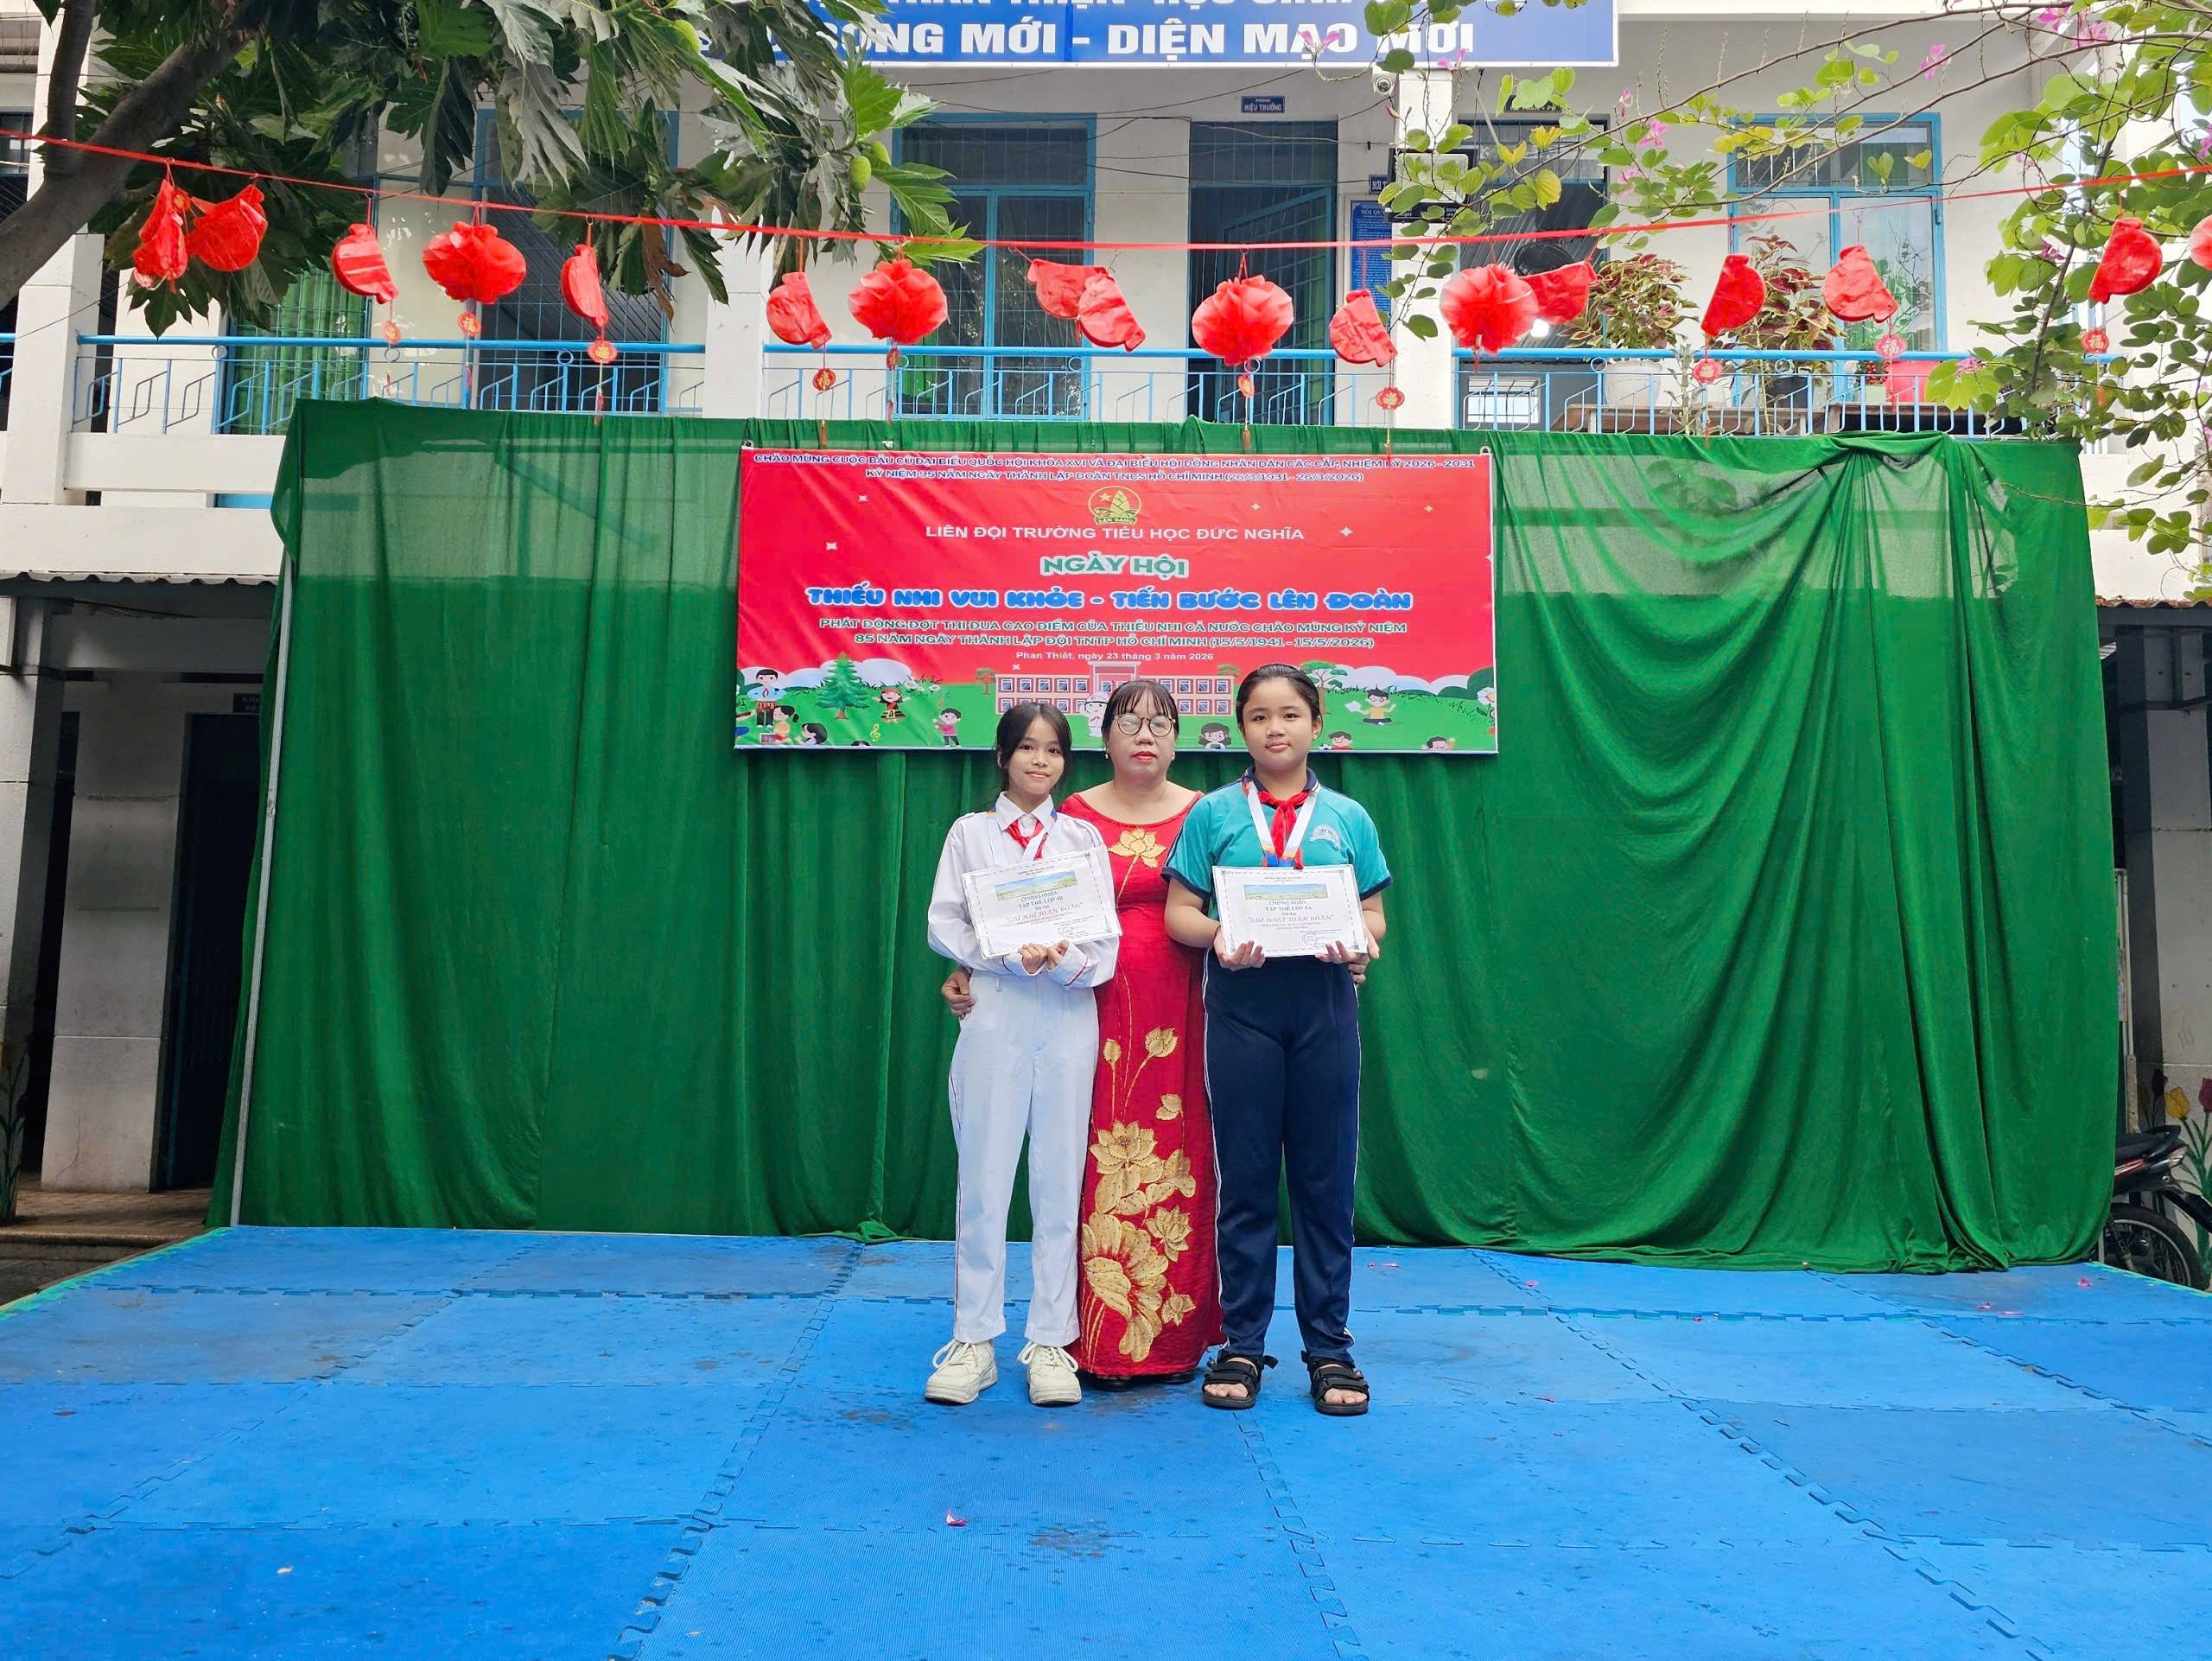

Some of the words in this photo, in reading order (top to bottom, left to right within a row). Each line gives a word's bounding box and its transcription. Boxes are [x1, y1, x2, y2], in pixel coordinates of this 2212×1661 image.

[960, 16, 1058, 54] MỚI
[1108, 19, 1227, 60] DIỆN
[1243, 22, 1357, 60] MẠO
[754, 454, 790, 463] CHÀO
[792, 454, 830, 464] MỪNG
[832, 455, 866, 466] CUỘC
[869, 454, 893, 465] BẦU
[912, 456, 938, 468] ĐẠI
[939, 455, 967, 466] BIỂU
[968, 455, 1003, 467] QUỐC
[1006, 456, 1028, 468] HỘI
[1065, 458, 1085, 468] XVI
[1090, 456, 1103, 468] VÀ
[1107, 458, 1128, 469] ĐẠI
[1130, 456, 1158, 468] BIỂU
[1160, 458, 1181, 469] HỘI
[1184, 457, 1218, 468] ĐỒNG
[1222, 458, 1255, 468] NHÂN
[1258, 458, 1284, 468] DÂN
[1287, 458, 1312, 468] CÁC
[1343, 458, 1382, 470] NHIỆM
[1404, 460, 1435, 468] 2026
[1444, 460, 1475, 468] 2031
[885, 468, 917, 480] NIỆM
[938, 468, 966, 479] NĂM
[969, 469, 1001, 480] NGÀY
[1006, 469, 1047, 480] THÀNH
[1050, 470, 1073, 481] LẬP
[1076, 470, 1110, 481] ĐOÀN
[1114, 472, 1146, 481] TNCS
[1148, 470, 1166, 481] HỒ
[1168, 471, 1188, 481] CHÍ
[1190, 472, 1224, 481] MINH
[1225, 473, 1288, 482] (26/3/1931
[1296, 473, 1364, 482] 26/3/2026)
[925, 525, 968, 538] LIÊN
[974, 526, 1007, 540] ĐỘI
[1013, 525, 1096, 539] TRƯỜNG
[1102, 525, 1144, 539] TIỂU
[1150, 528, 1190, 542] HỌC
[1196, 526, 1237, 540] ĐỨC
[1244, 527, 1305, 540] NGHĨA
[1040, 551, 1127, 576] NGÀY
[1130, 555, 1188, 579] HỘI
[806, 582, 886, 608] THIẾU
[893, 589, 942, 608] NHI
[949, 589, 999, 608] VUI
[1005, 586, 1084, 609] KHỎE
[1111, 586, 1172, 610] TIẾN
[1177, 589, 1261, 610] BƯỚC
[1268, 589, 1318, 610] LÊN
[1325, 589, 1413, 611] ĐOÀN
[820, 617, 859, 628] PHÁT
[943, 620, 967, 630] THI
[969, 621, 1000, 631] ĐUA
[1003, 621, 1034, 631] CAO
[1036, 619, 1074, 631] ĐIỂM
[1077, 620, 1108, 631] CỦA
[1156, 622, 1182, 632] NHI
[1185, 621, 1205, 633] CẢ
[1208, 622, 1252, 633] NƯỚC
[1253, 621, 1294, 633] CHÀO
[1297, 621, 1342, 633] MỪNG
[1368, 622, 1407, 633] NIỆM
[855, 633, 874, 644] 85
[877, 633, 912, 644] NĂM
[915, 634, 956, 645] NGÀY
[959, 634, 1011, 645] THÀNH
[1014, 634, 1043, 646] LẬP
[1046, 635, 1071, 646] ĐỘI
[1075, 636, 1115, 646] TNTP
[1117, 633, 1138, 646] HỒ
[1141, 636, 1166, 646] CHÍ
[1168, 638, 1208, 646] MINH
[1210, 637, 1283, 647] (15/5/1941
[1294, 637, 1374, 648] 15/5/2026)
[1016, 652, 1043, 660] Phan
[1077, 652, 1103, 662] ngày
[1122, 652, 1152, 662] tháng
